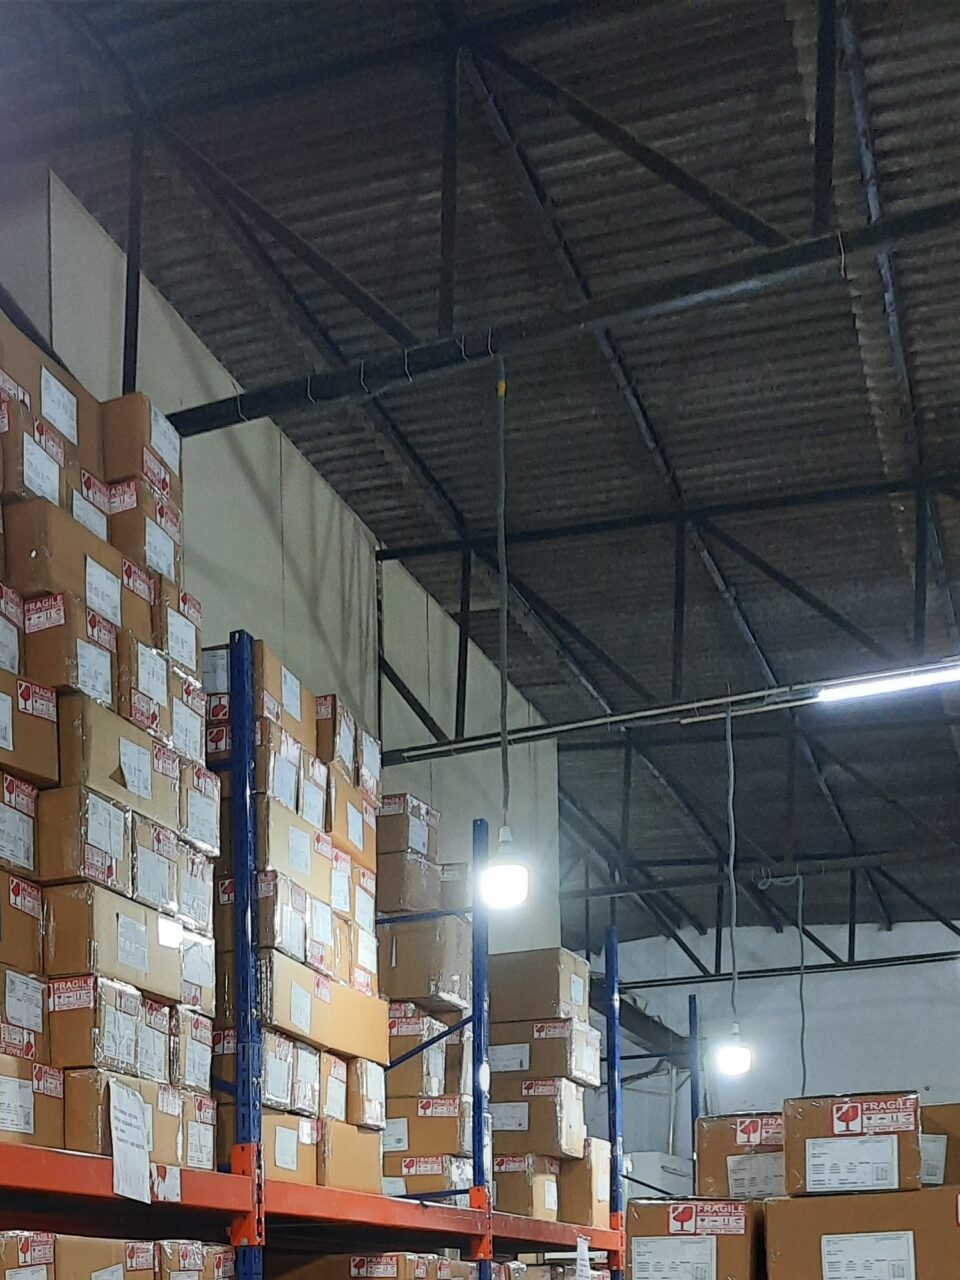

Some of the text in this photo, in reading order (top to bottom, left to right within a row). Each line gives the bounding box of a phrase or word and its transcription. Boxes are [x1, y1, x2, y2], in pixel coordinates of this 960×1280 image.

[24, 594, 64, 611] FRAGILE
[54, 979, 94, 989] FRAGILE
[863, 1100, 914, 1110] FRAGILE
